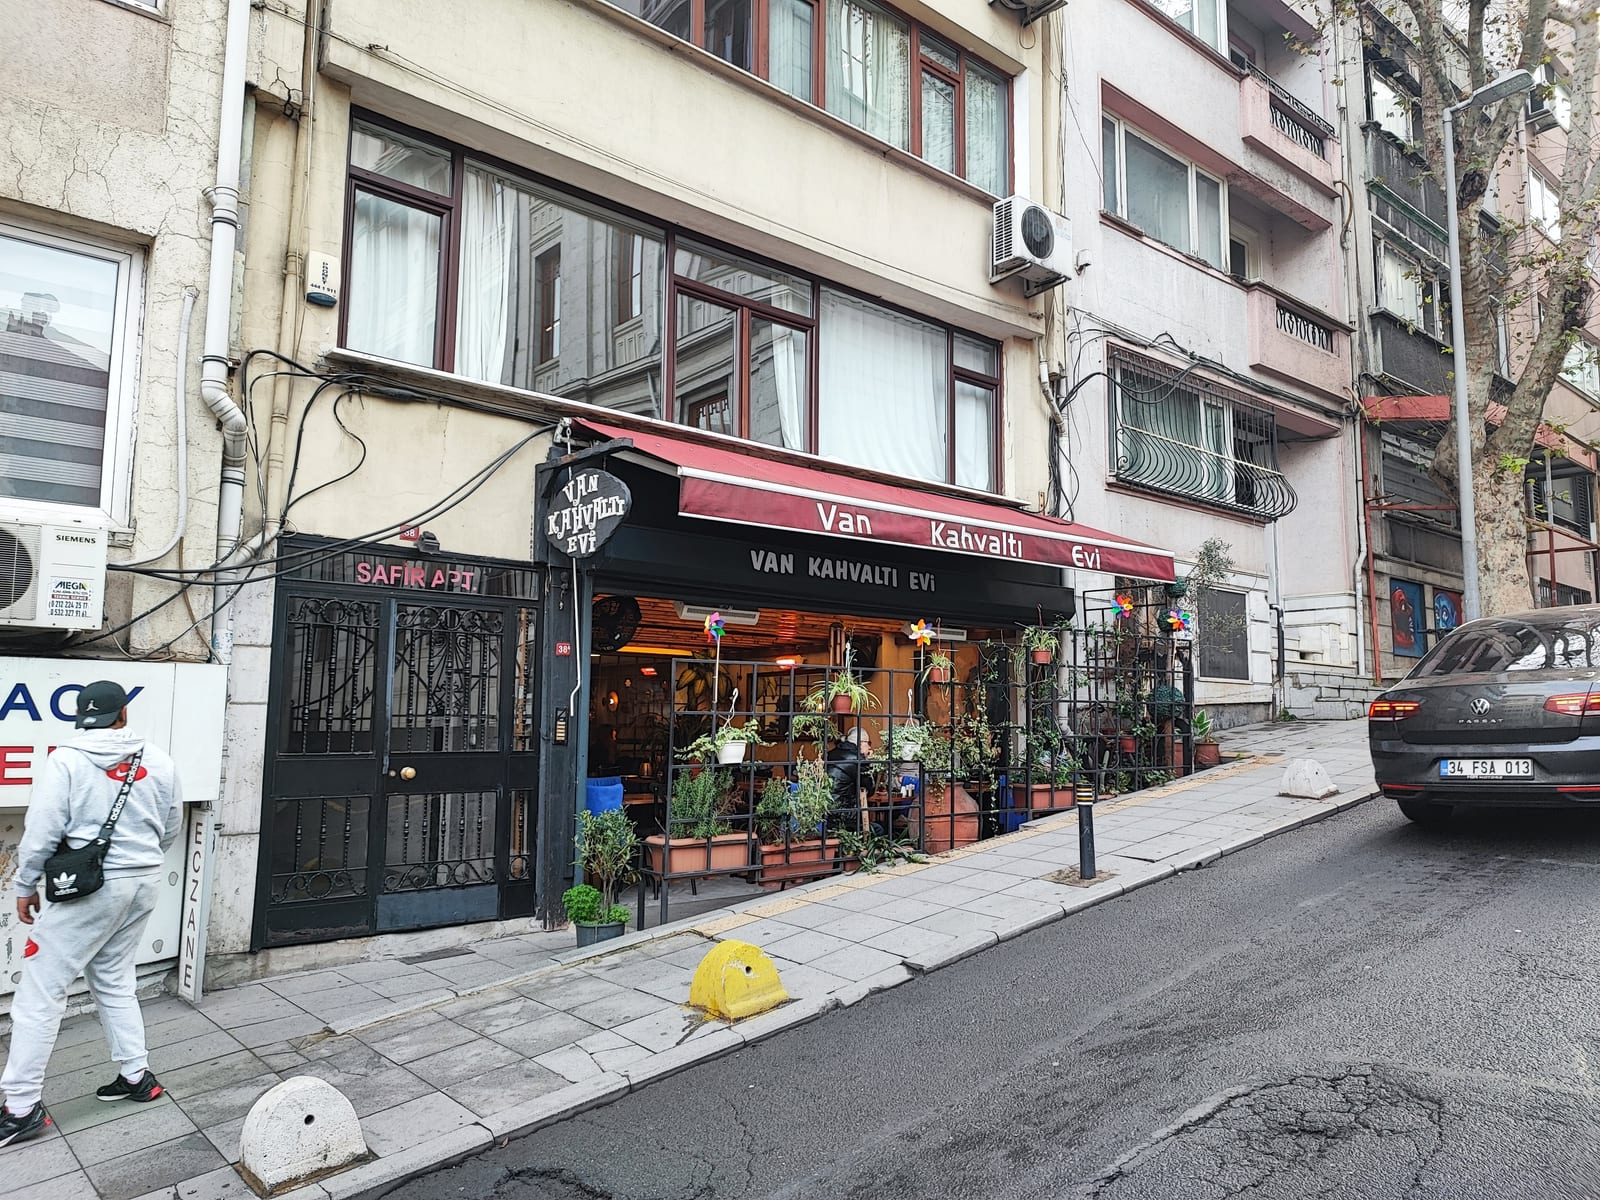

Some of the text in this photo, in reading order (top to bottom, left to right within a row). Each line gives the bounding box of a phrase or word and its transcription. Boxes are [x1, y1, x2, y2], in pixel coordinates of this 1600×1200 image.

[562, 474, 599, 506] VAN
[547, 496, 625, 539] KAHVALTI
[56, 535, 96, 544] SIEMENS
[816, 503, 1101, 570] Van Kahvaltı Evi
[356, 562, 426, 588] SAFİR
[750, 550, 794, 575] VAN
[808, 556, 898, 588] KAHVALTI
[54, 581, 87, 590] MEGA
[126, 758, 141, 784] adidas
[1448, 761, 1530, 775] 34 FSA 013
[110, 794, 127, 821] adidas
[54, 887, 79, 896] adidas
[183, 822, 204, 989] ECZANE
